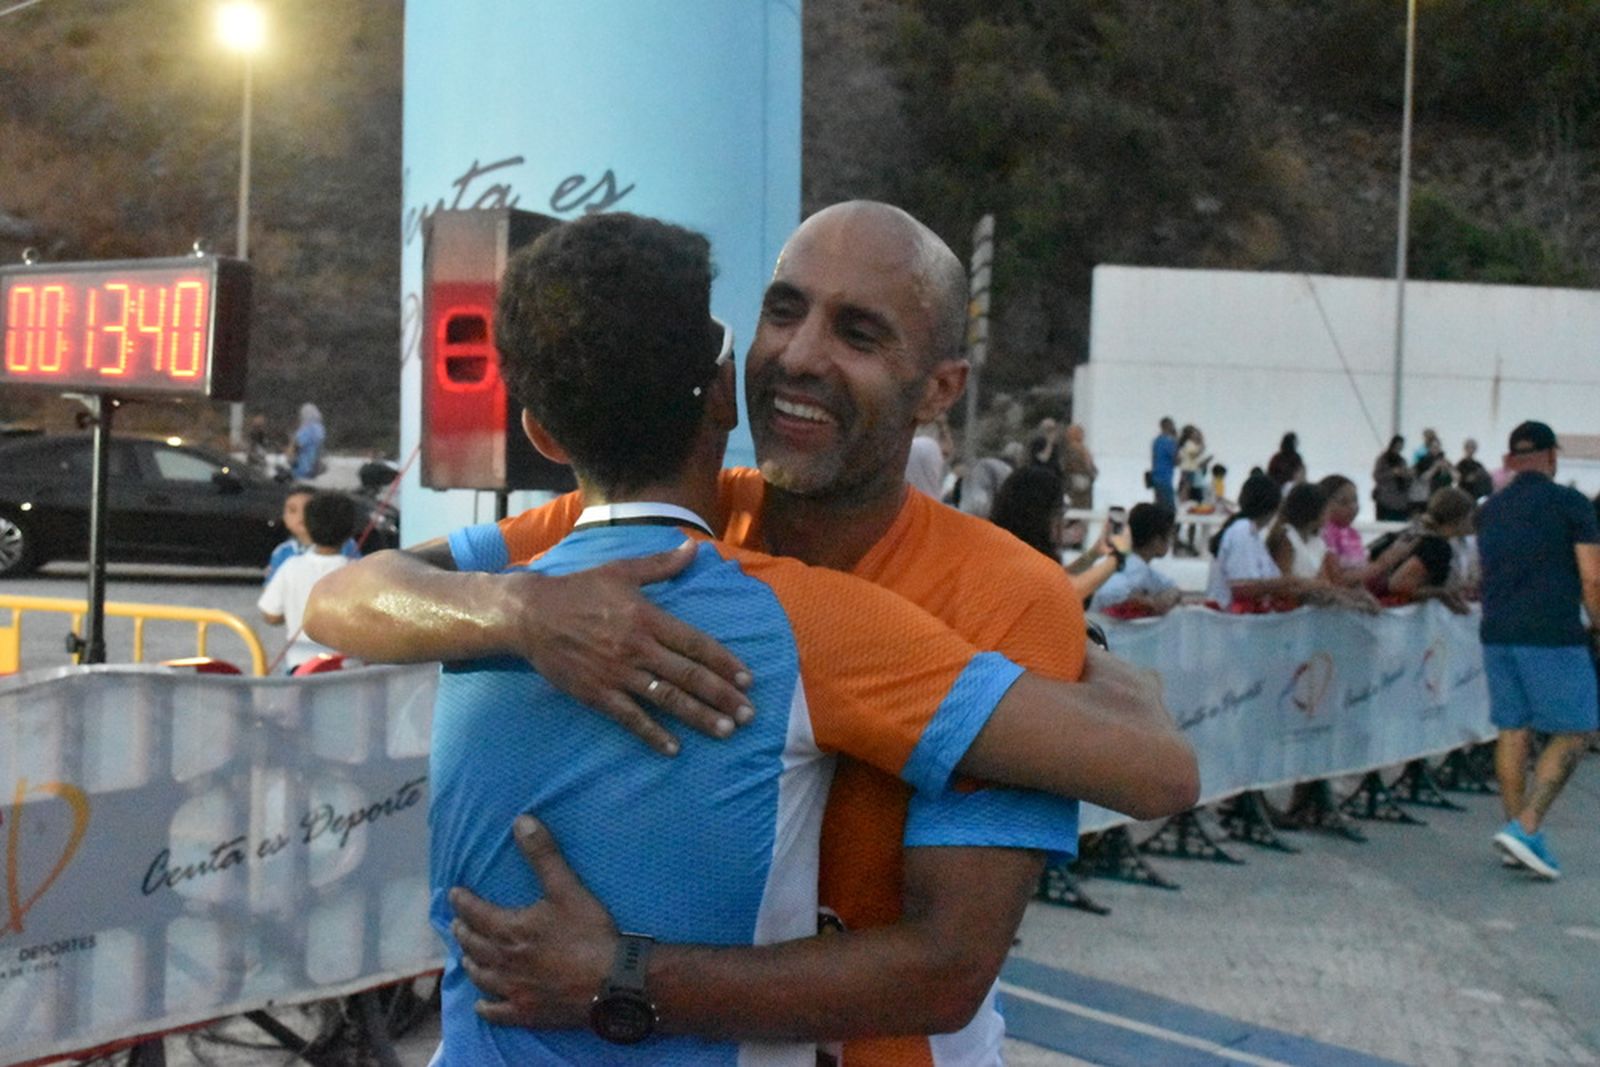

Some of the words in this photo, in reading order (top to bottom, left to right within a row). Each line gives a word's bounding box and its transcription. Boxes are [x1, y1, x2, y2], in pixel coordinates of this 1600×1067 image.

[550, 168, 635, 214] es
[141, 834, 248, 896] Ceuta
[256, 832, 291, 860] es
[299, 775, 428, 849] Deporte
